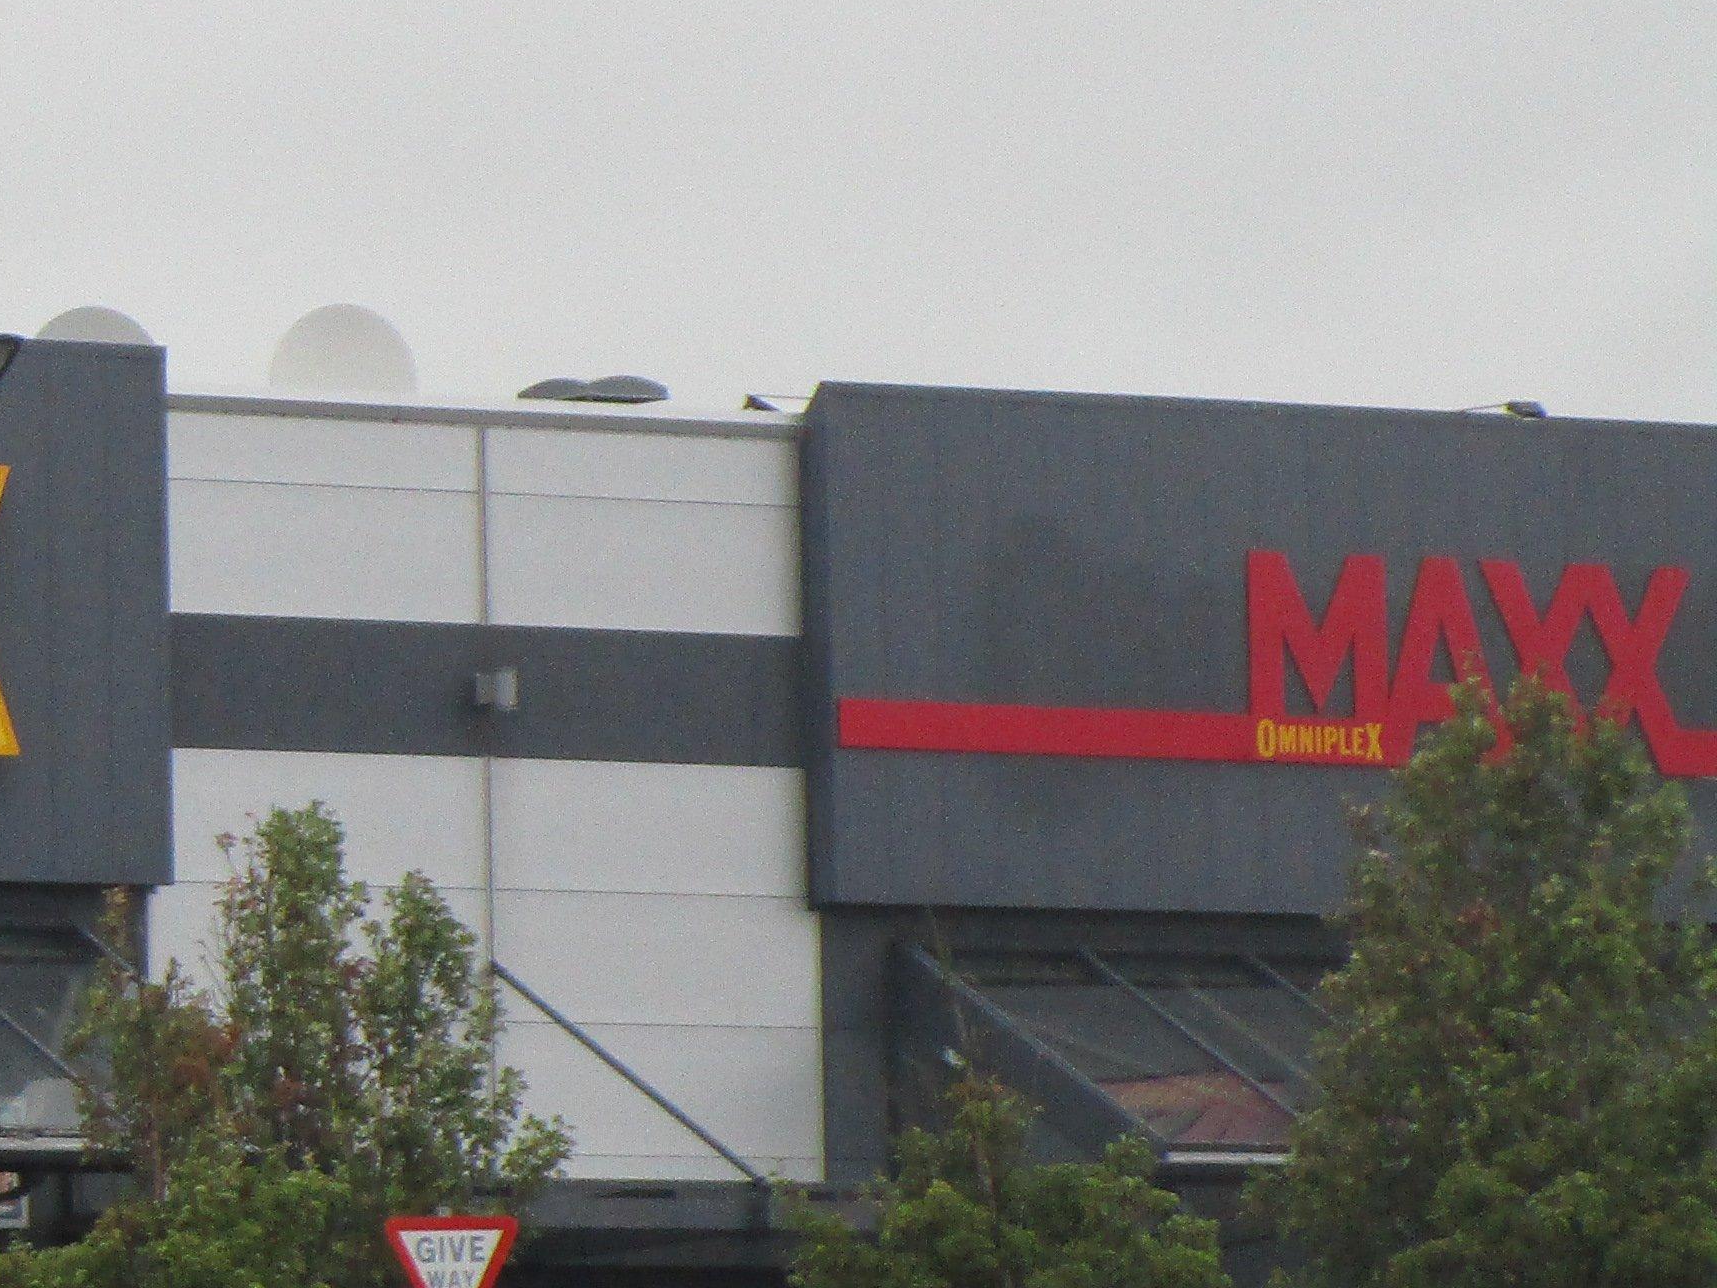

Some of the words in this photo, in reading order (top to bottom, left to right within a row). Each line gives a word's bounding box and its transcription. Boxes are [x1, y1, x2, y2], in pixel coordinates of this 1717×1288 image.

[1246, 550, 1691, 778] MAXX
[1257, 718, 1383, 760] OMNIPLEX
[417, 1235, 485, 1263] GIVE
[428, 1270, 476, 1288] WAY
